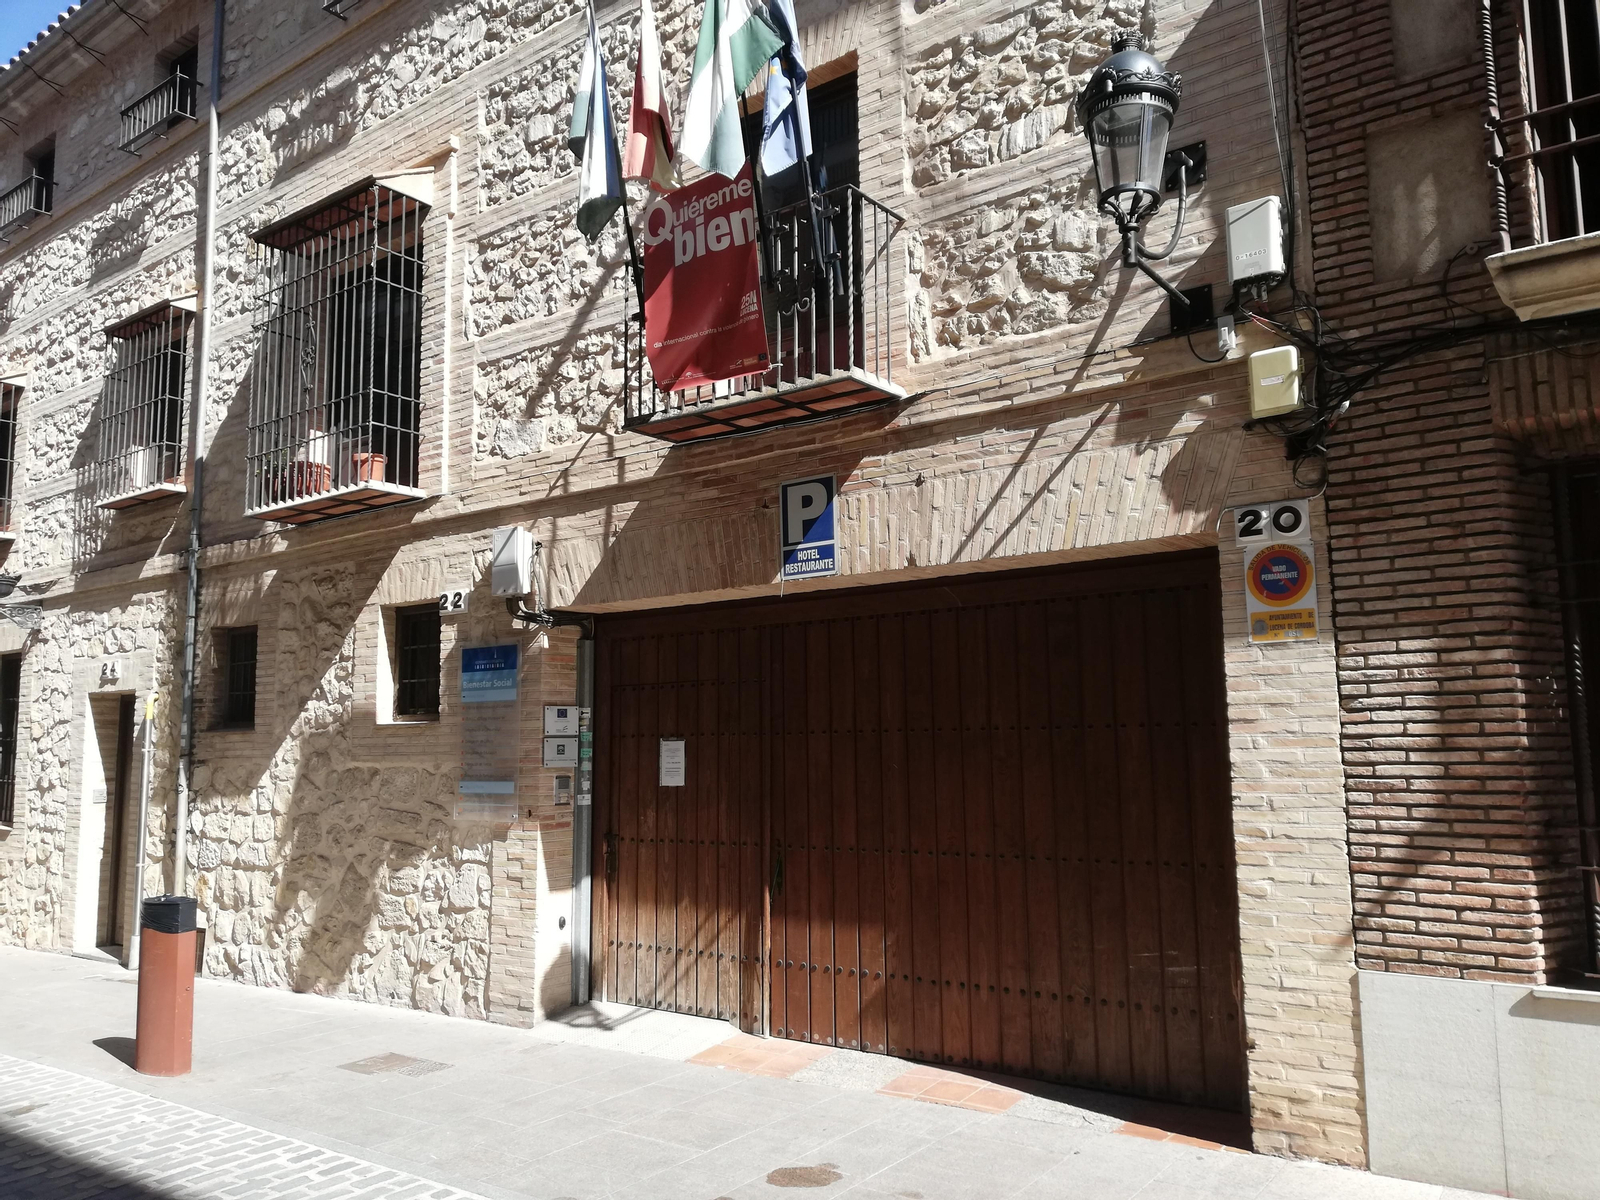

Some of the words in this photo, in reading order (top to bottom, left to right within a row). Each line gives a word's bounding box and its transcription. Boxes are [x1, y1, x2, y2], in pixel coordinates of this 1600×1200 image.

[643, 178, 752, 246] Quiéreme
[674, 207, 755, 267] bien
[740, 290, 758, 310] 25N
[664, 331, 699, 346] internacional
[699, 326, 718, 337] contra
[786, 482, 828, 544] P
[1238, 505, 1303, 538] 20
[797, 549, 820, 561] HOTEL
[1248, 552, 1268, 571] SALIDA
[1267, 545, 1277, 554] DE
[785, 558, 834, 574] RESTAURANTE
[1272, 565, 1288, 573] VADO
[1261, 571, 1299, 581] PERMANENTE
[439, 591, 463, 611] 22
[1269, 612, 1303, 621] AYUNTAMIENTO
[1308, 611, 1315, 619] DE
[1269, 623, 1287, 632] LUCENA
[1287, 622, 1294, 630] DE
[101, 662, 116, 677] 24
[463, 680, 492, 690] Bienestar
[493, 678, 513, 688] Social
